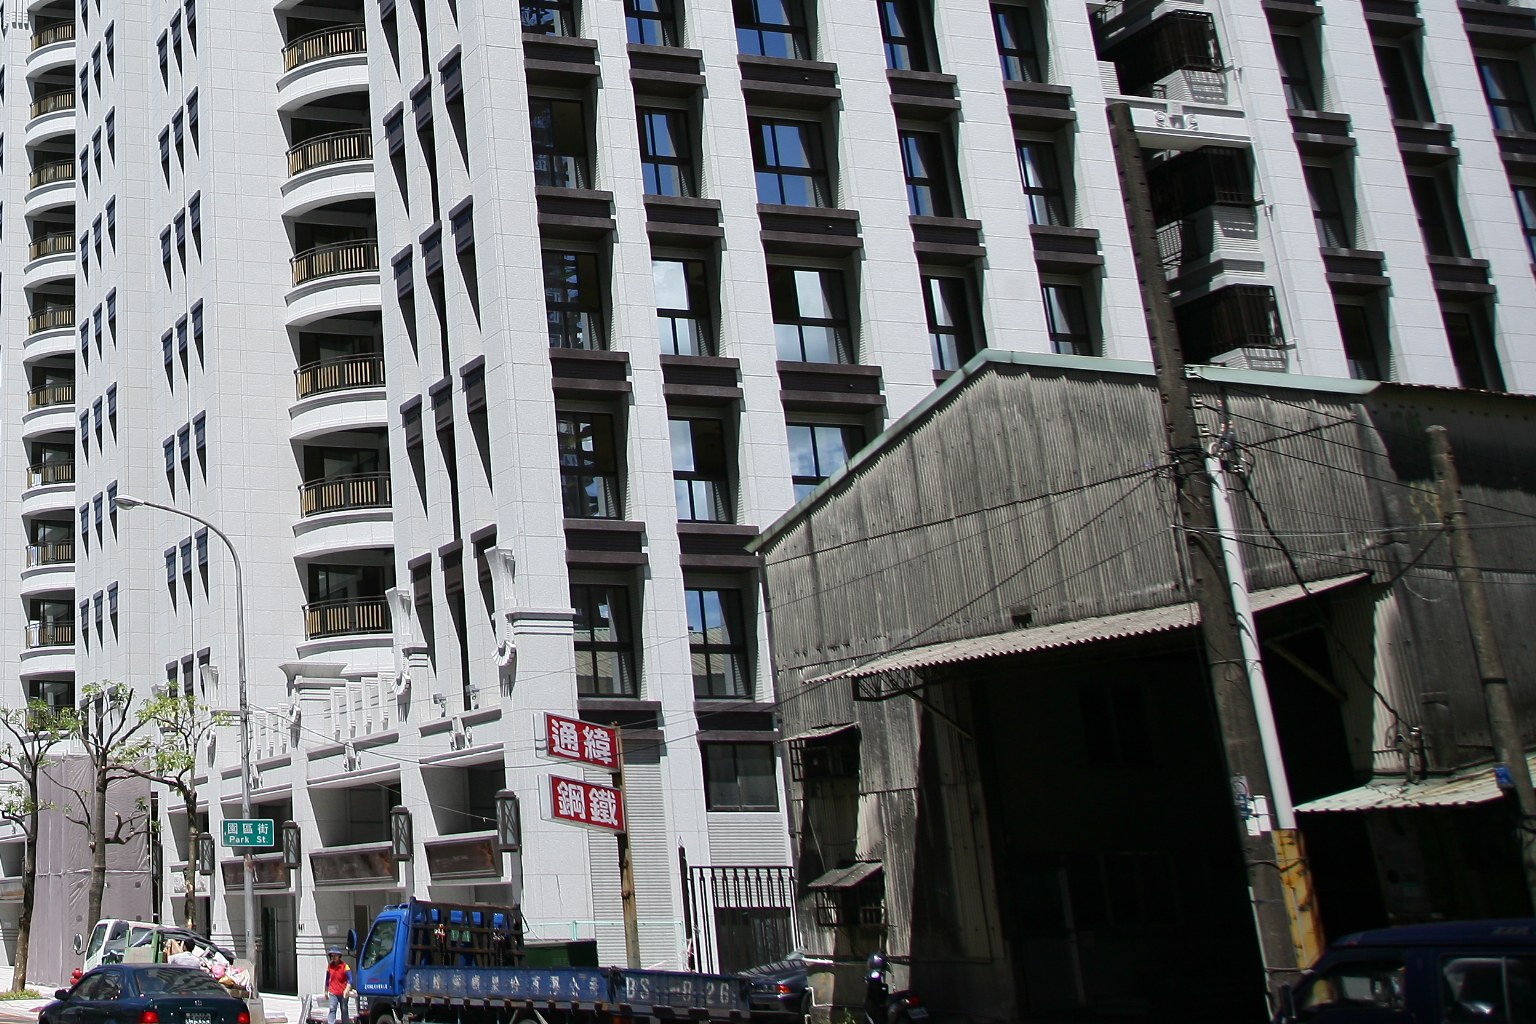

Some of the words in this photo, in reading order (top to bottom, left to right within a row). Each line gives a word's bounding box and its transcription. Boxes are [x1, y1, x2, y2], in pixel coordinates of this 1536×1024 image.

[557, 780, 618, 826] 鋼鐵
[227, 822, 269, 835] 園區街
[229, 835, 250, 843] Park
